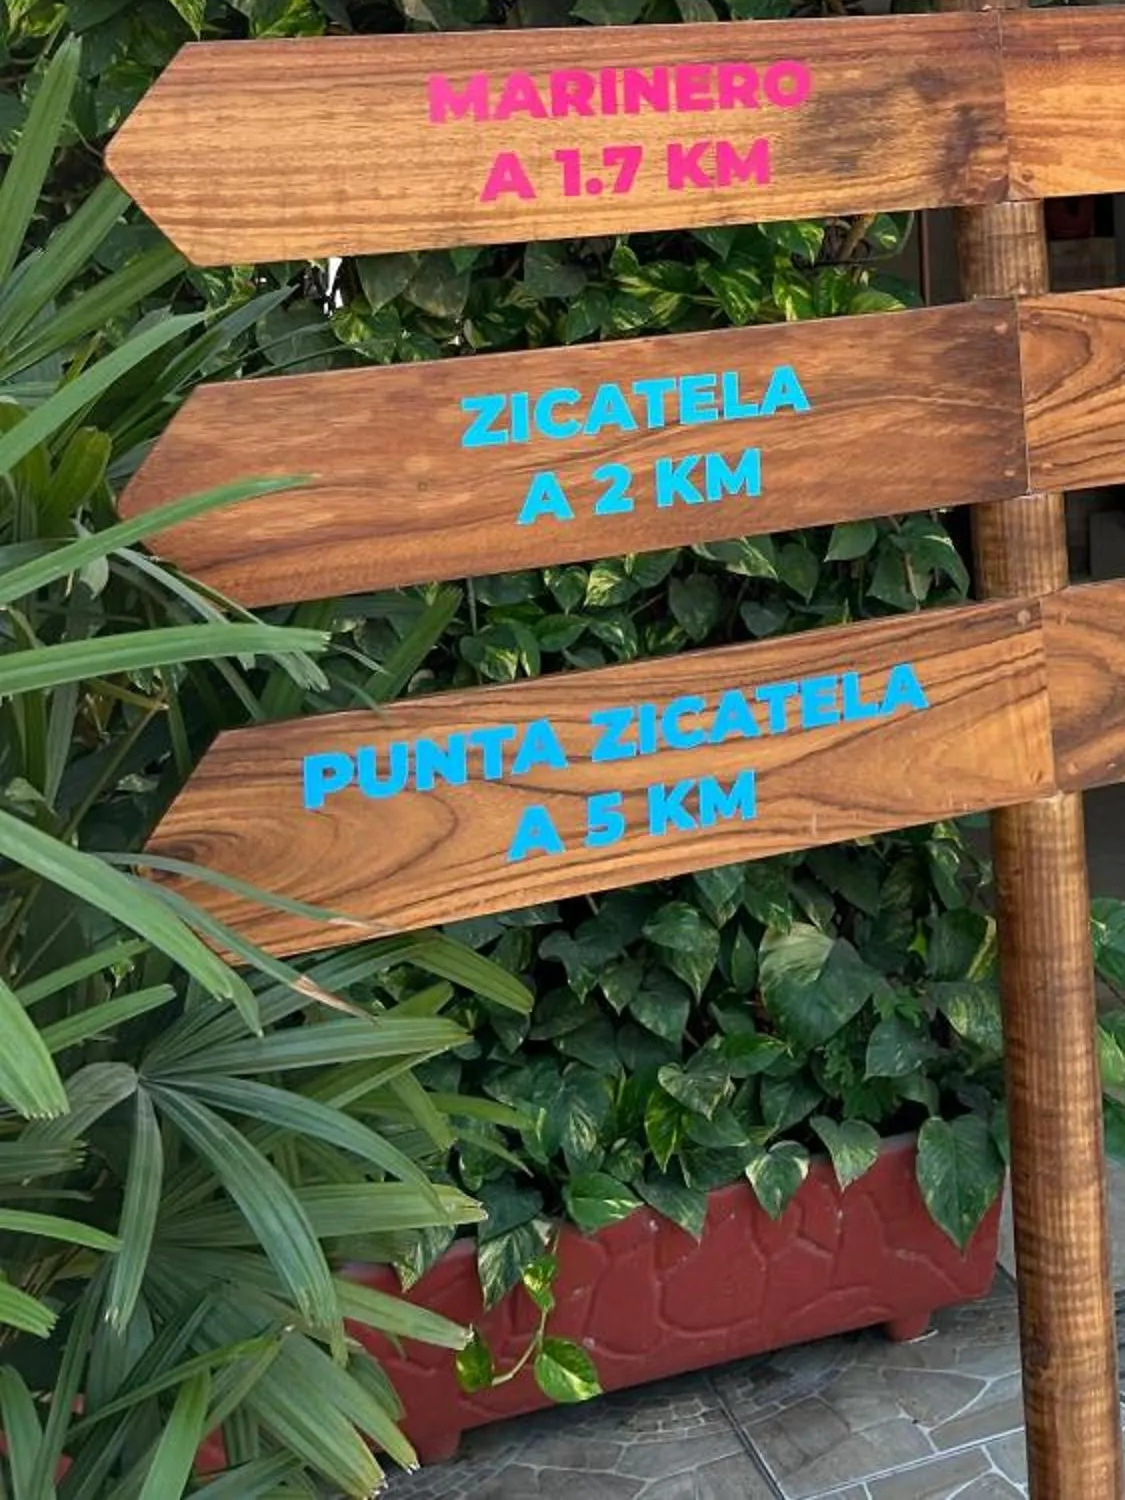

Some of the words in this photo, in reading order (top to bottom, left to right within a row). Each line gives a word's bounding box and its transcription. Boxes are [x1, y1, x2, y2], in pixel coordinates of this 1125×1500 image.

[429, 59, 810, 122] MARINERO
[481, 153, 533, 200] A
[553, 147, 641, 196] 1.7
[668, 140, 769, 188] KM
[460, 365, 811, 449] ZICATELA
[520, 474, 571, 522] A
[596, 465, 631, 513] 2
[657, 449, 759, 505] KM
[302, 719, 567, 811] PUNTA
[592, 665, 927, 760] ZICATELA
[510, 807, 561, 859] A
[587, 792, 625, 845] 5
[649, 772, 755, 834] KM
